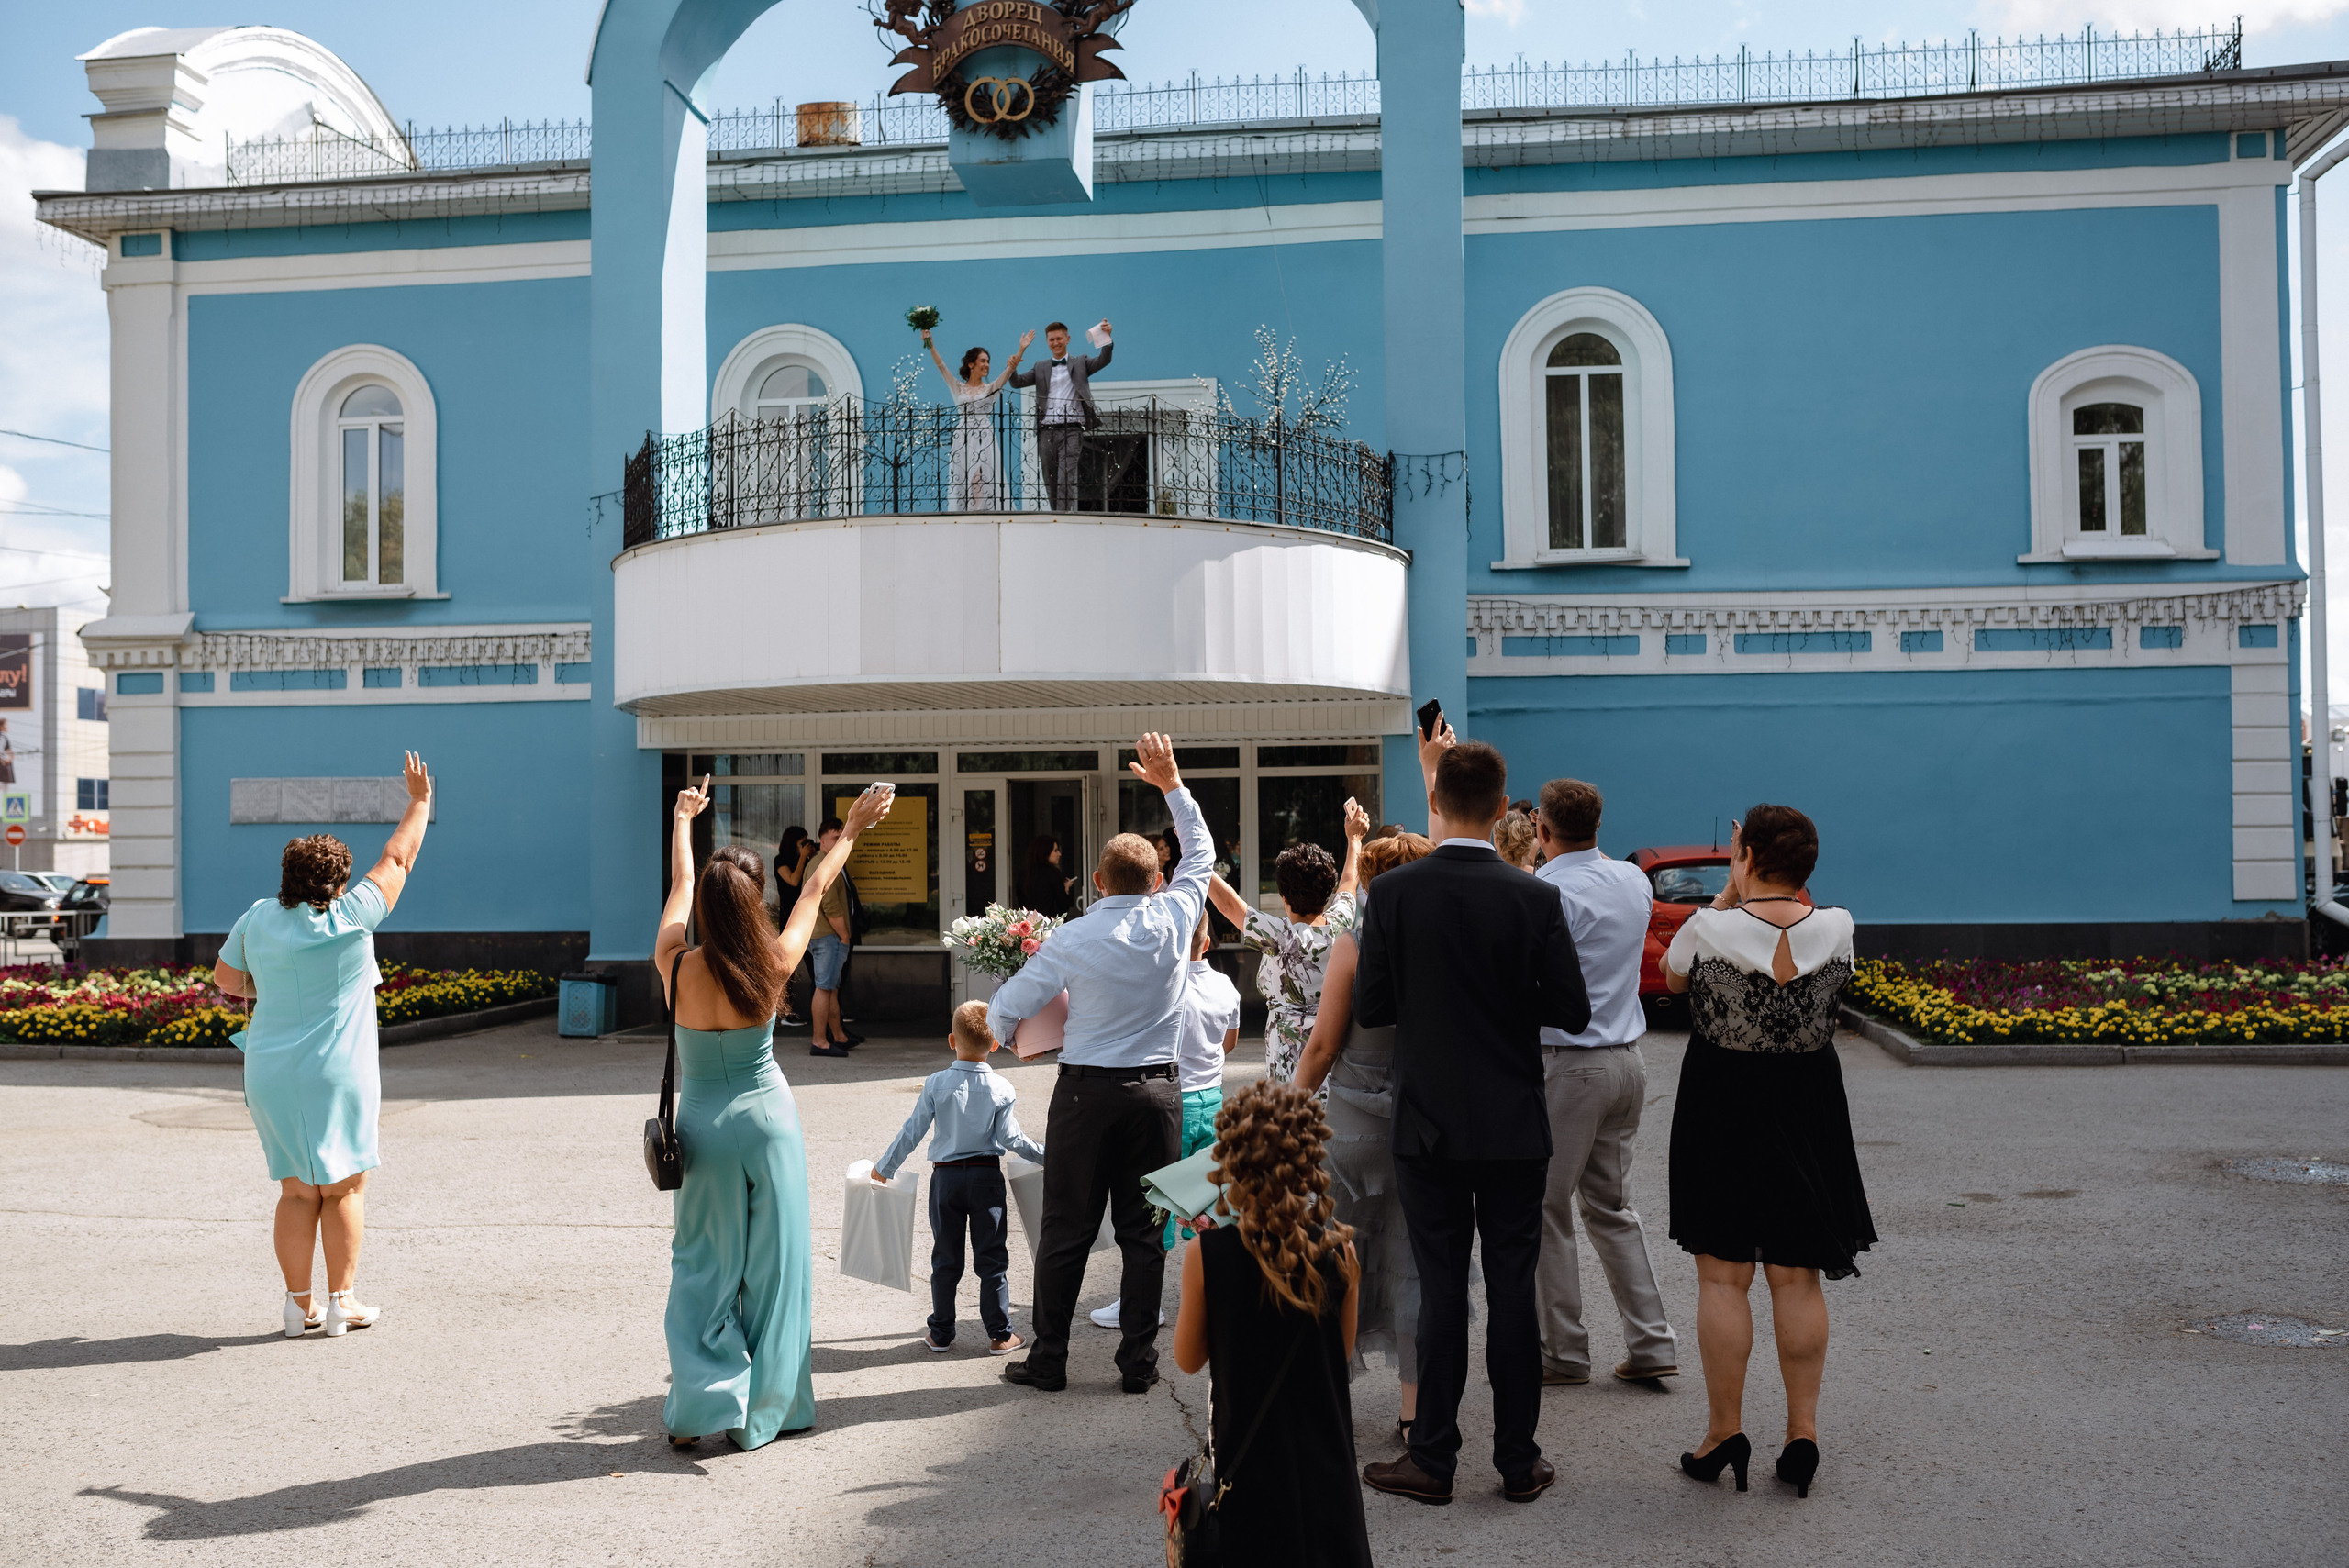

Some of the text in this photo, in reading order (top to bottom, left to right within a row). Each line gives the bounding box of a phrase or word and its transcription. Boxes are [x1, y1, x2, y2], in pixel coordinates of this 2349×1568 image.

[963, 1, 1043, 32] ДВОРЕЦ
[932, 23, 1075, 81] БРАКОСОЧЕТАНИЯ
[0, 663, 27, 688] лу!
